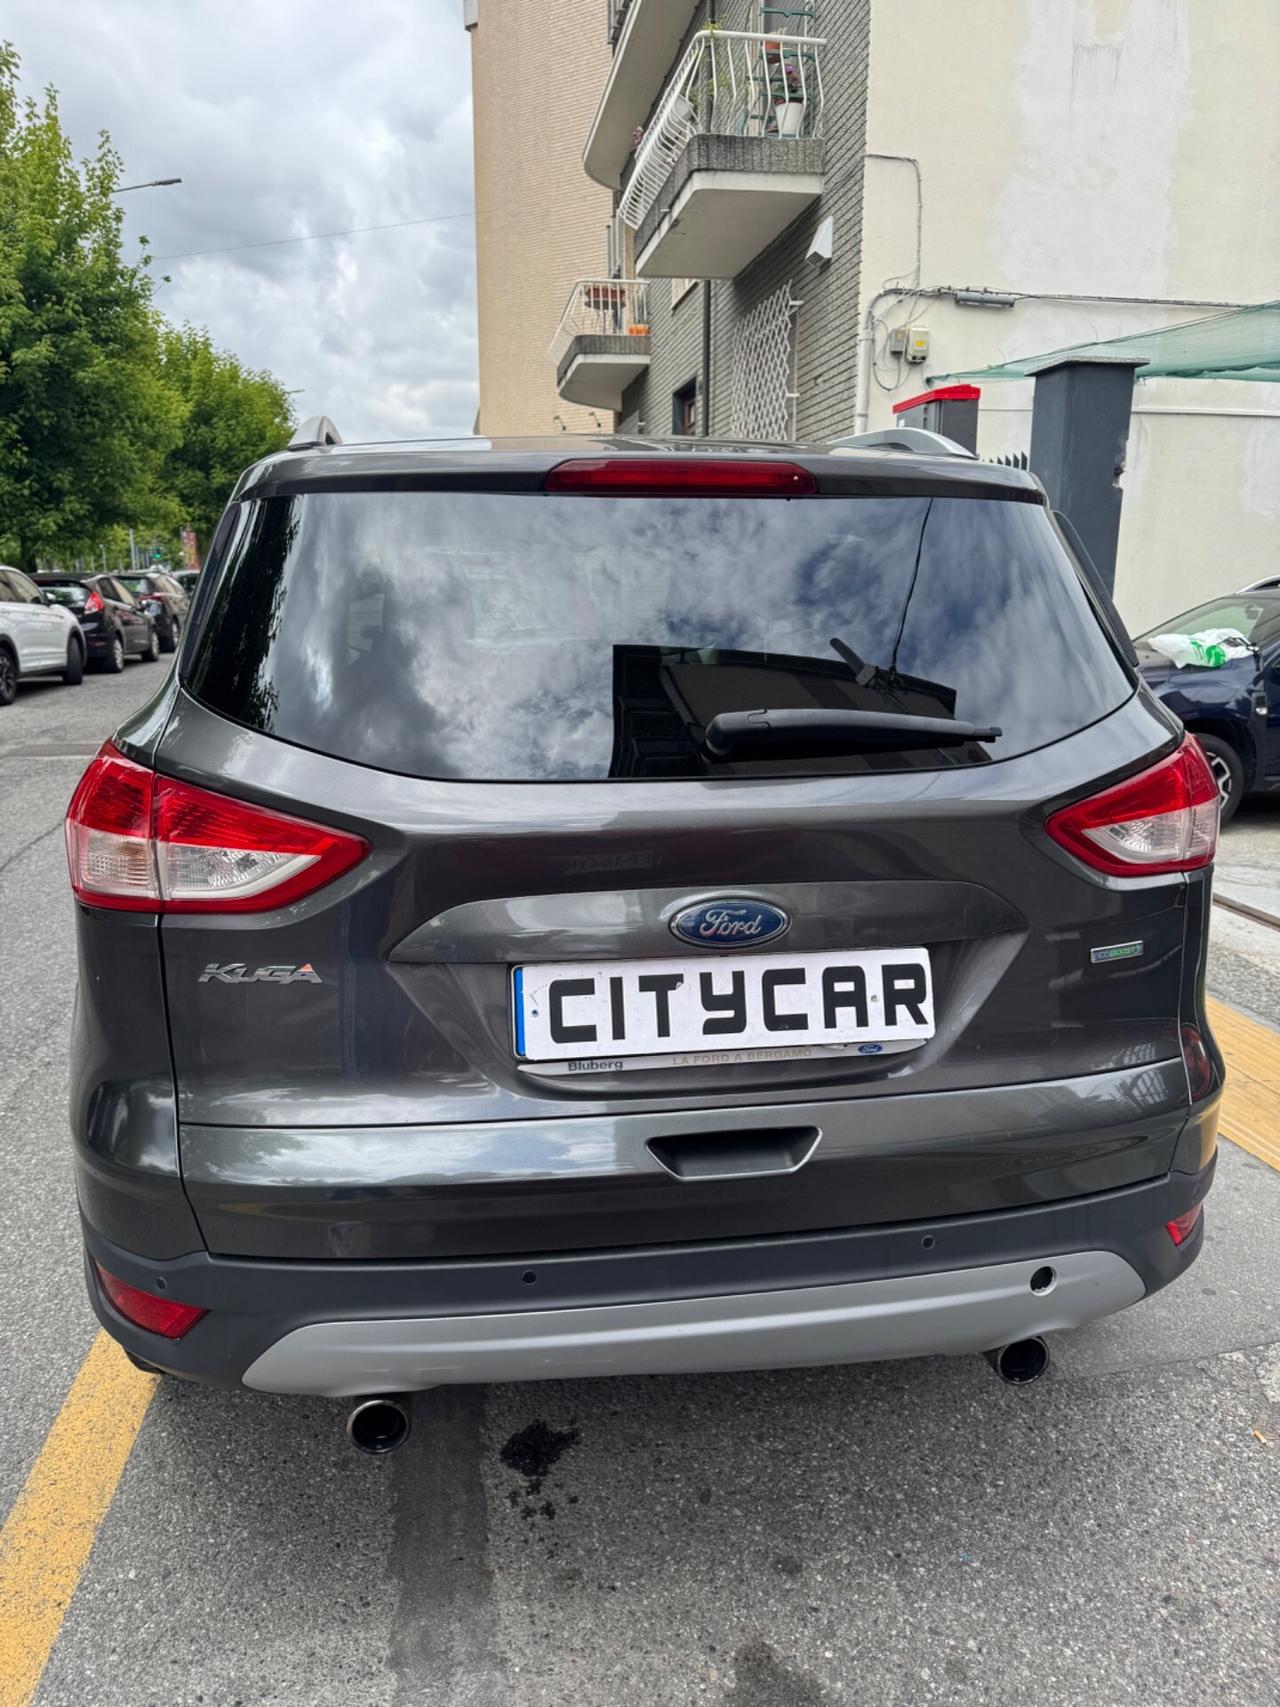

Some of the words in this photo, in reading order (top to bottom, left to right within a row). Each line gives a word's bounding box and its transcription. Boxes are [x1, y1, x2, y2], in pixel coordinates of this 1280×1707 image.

[699, 909, 762, 937] Ford
[549, 963, 929, 1044] CITYCAR
[567, 1060, 624, 1072] Bluberg
[673, 1056, 690, 1066] LA
[693, 1053, 730, 1065] FORD
[734, 1053, 745, 1062] A
[747, 1049, 813, 1061] BERGAMO
